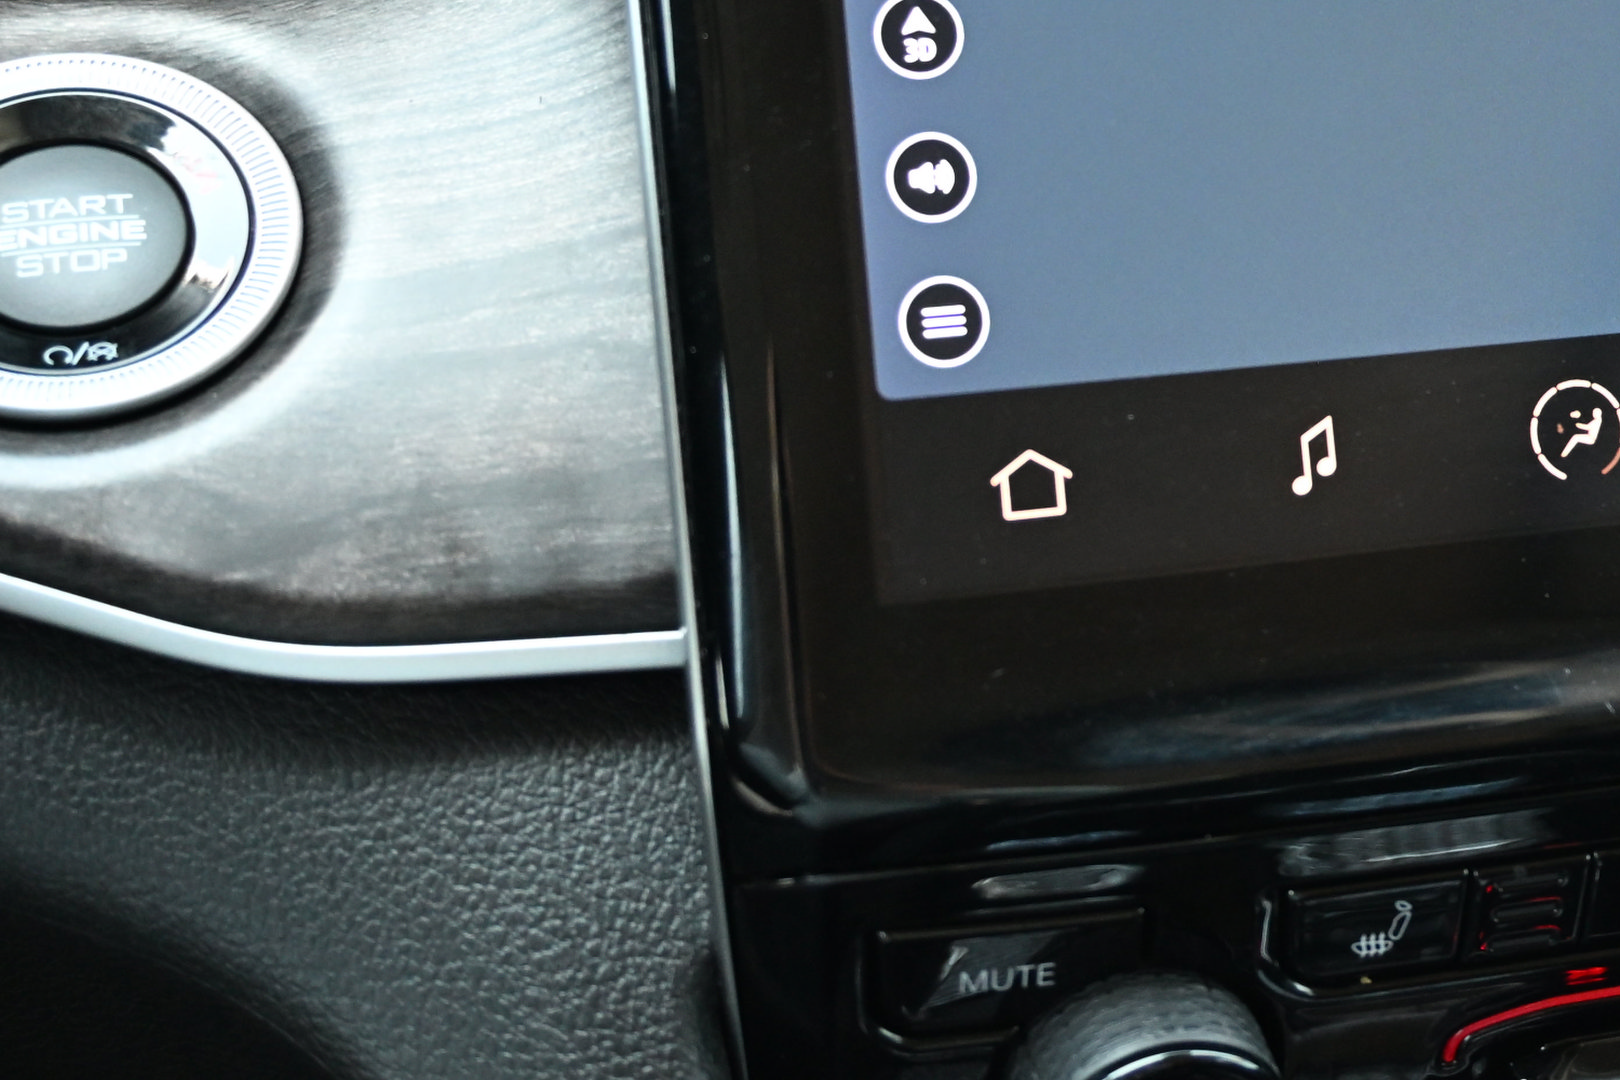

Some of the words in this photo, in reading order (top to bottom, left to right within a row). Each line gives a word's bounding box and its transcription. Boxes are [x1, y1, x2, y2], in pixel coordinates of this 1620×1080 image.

[903, 38, 938, 64] 3D
[1, 193, 134, 223] START
[0, 219, 147, 251] ENGINE
[15, 248, 128, 278] STOP
[957, 962, 1055, 995] MUTE
